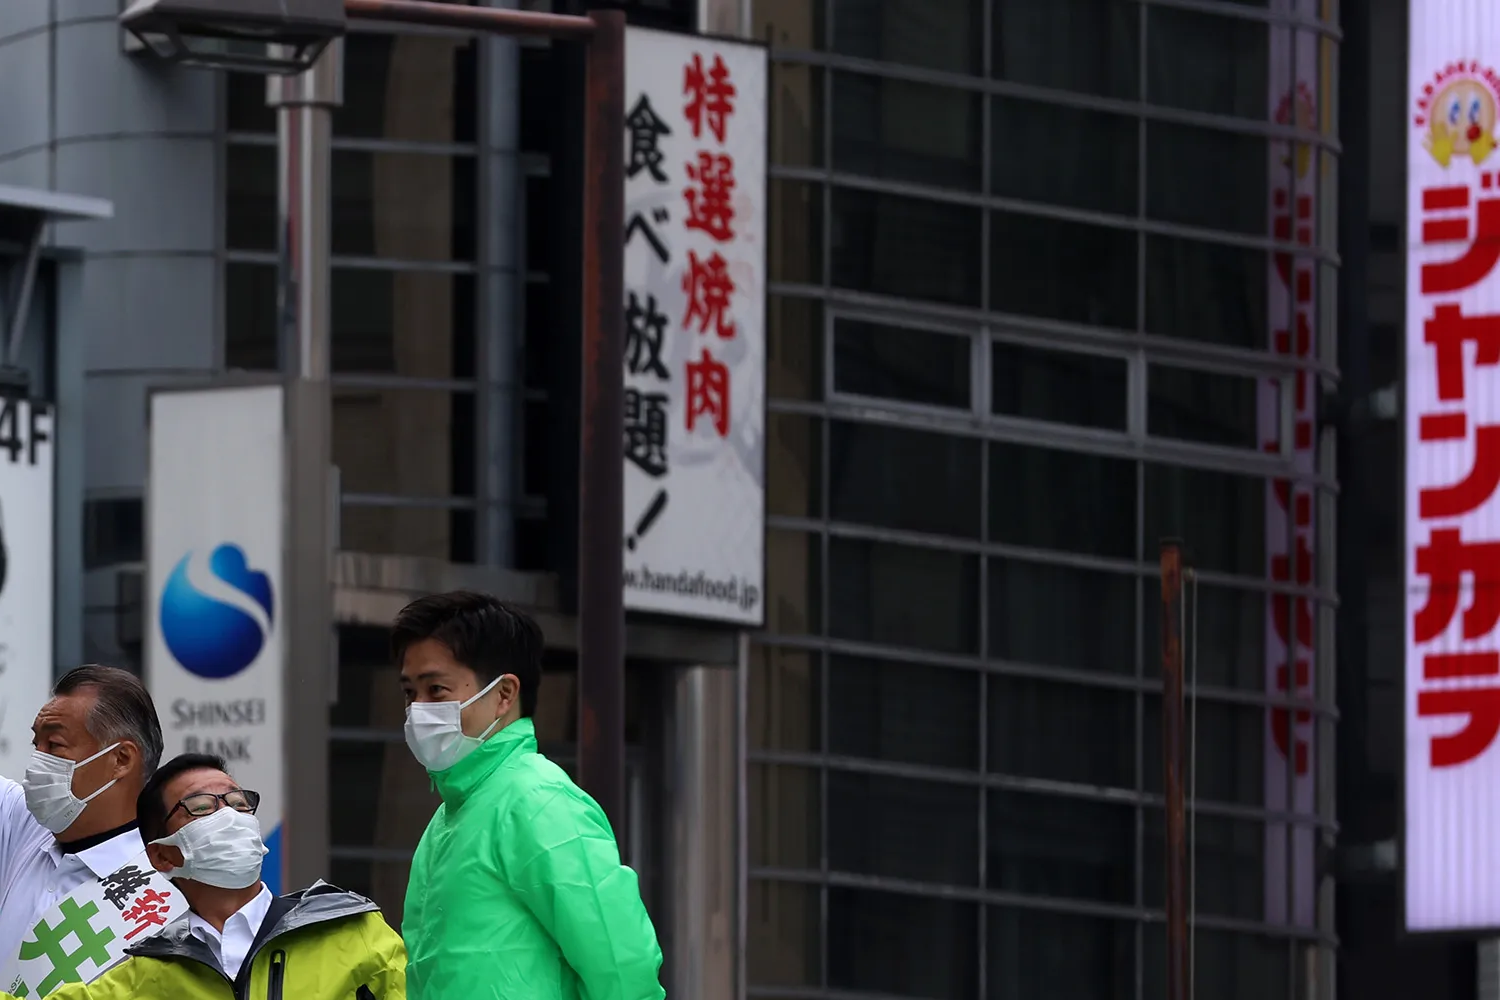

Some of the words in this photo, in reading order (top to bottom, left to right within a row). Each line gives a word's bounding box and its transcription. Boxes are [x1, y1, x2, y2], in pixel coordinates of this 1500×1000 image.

[681, 51, 737, 440] 特選焼肉
[1414, 172, 1500, 770] ジャンカラ
[170, 697, 267, 730] SHINSEI
[183, 734, 254, 762] BANK
